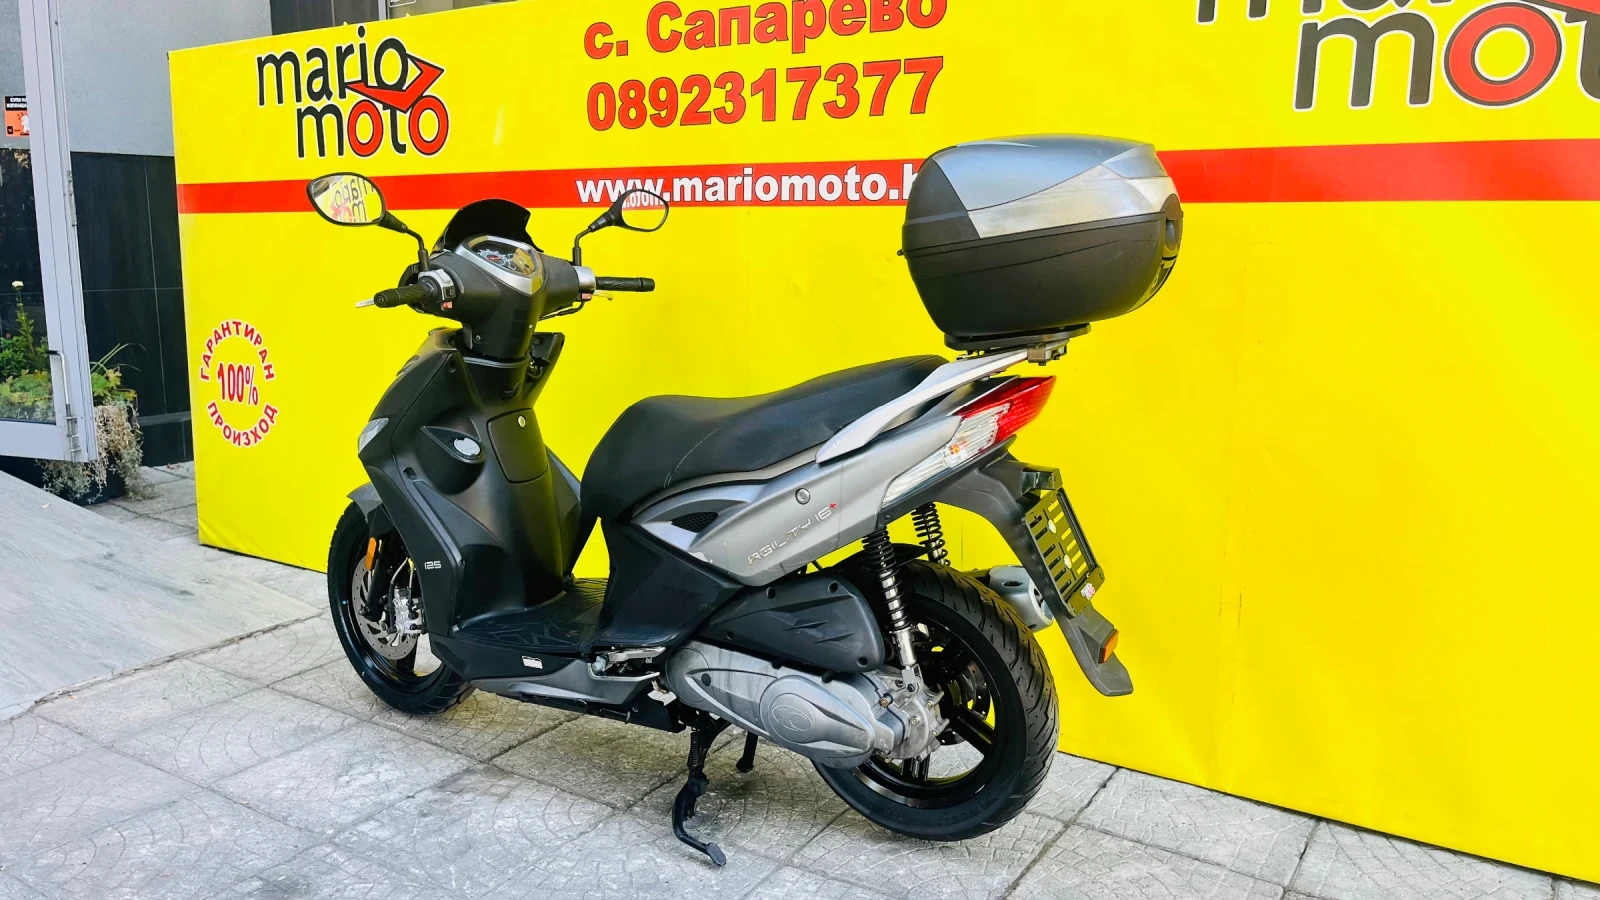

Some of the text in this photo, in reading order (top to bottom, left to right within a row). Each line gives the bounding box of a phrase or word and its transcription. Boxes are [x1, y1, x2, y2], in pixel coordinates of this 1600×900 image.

[584, 0, 948, 60] с. Сапарево
[256, 25, 409, 106] mario
[586, 56, 944, 132] 0892317377
[296, 95, 449, 158] moto
[200, 320, 275, 381] ГАРАНТИРАН
[217, 362, 259, 406] 100%
[207, 401, 278, 447] ПРОИЗХОД
[424, 560, 442, 570] 125
[747, 518, 811, 566] AGILITY
